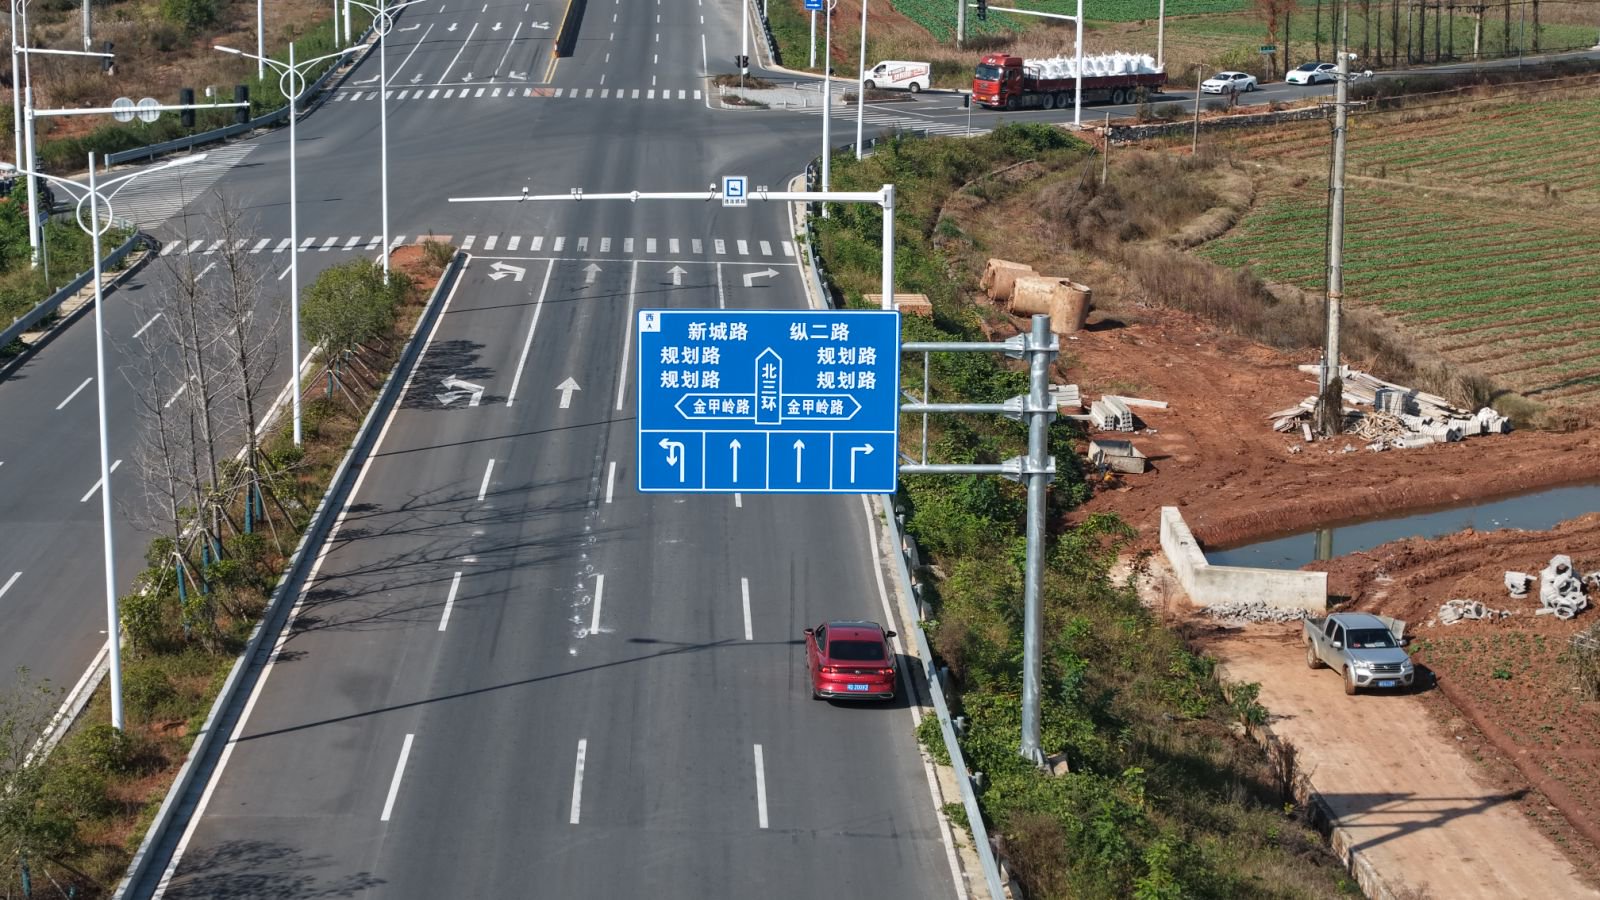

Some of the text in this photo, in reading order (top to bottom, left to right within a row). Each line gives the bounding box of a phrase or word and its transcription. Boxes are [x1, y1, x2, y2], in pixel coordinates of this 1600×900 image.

[688, 322, 748, 341] 新城路
[790, 322, 850, 341] 纵二路
[660, 346, 720, 365] 规划路
[817, 346, 877, 365] 规划路
[660, 370, 720, 389] 规划路
[761, 363, 777, 412] 北三环
[817, 371, 877, 389] 规划路
[693, 398, 750, 415] 金甲岭路
[787, 399, 844, 415] 金甲岭路
